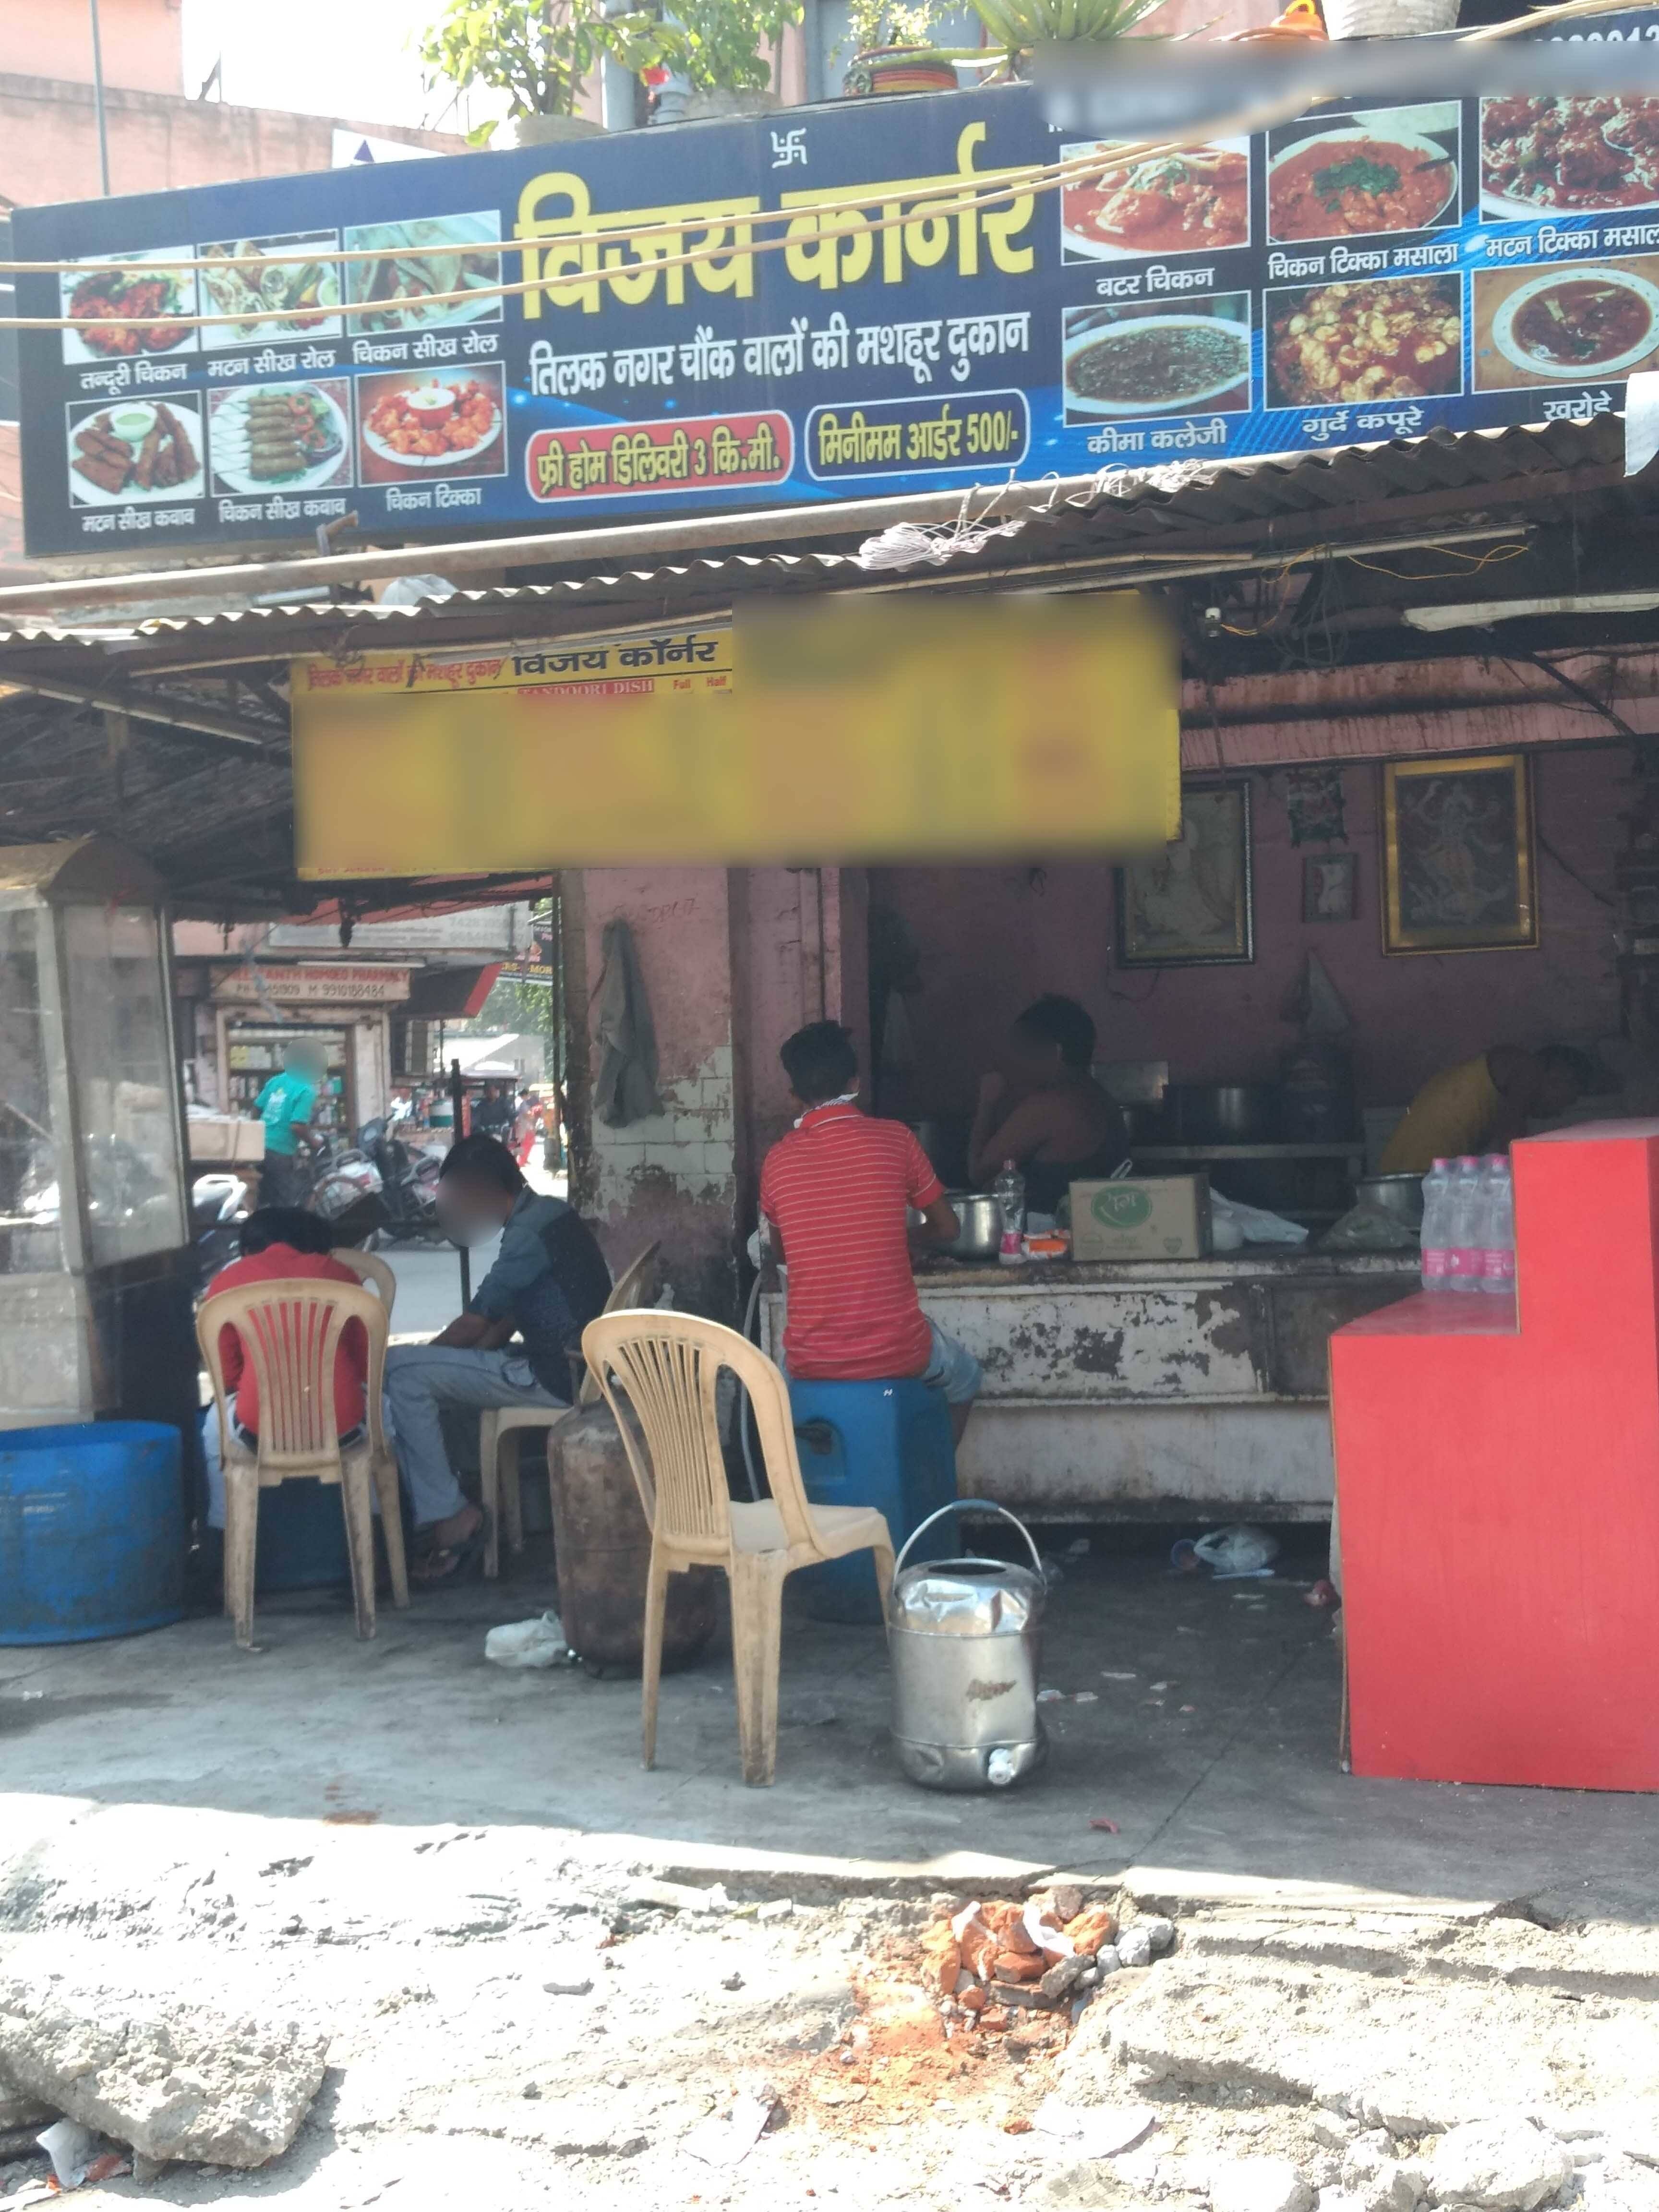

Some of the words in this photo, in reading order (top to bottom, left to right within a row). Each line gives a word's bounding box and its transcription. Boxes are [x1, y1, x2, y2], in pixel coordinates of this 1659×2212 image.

[513, 172, 760, 320] विजय
[780, 121, 1044, 290] कार्नर
[1485, 235, 1535, 257] मटन
[1538, 226, 1599, 254] टिक्का
[1603, 223, 1659, 247] मसाल
[1267, 252, 1326, 279] चिकन
[1329, 246, 1389, 274] टिक्का
[1393, 243, 1459, 267] मसाला
[1095, 275, 1142, 296] बटर
[1145, 265, 1215, 292] चिकन
[208, 359, 248, 377] मटन
[254, 350, 297, 374] सीख
[301, 345, 336, 369] रोल
[352, 340, 408, 365] चिकन
[413, 334, 457, 359] सीख
[462, 330, 499, 353] रोल
[529, 341, 608, 396] तिलक
[613, 346, 675, 386] नगर
[680, 325, 737, 382] चौंक
[742, 316, 809, 376] वालों
[811, 312, 850, 370] की
[855, 320, 943, 384] मशहूर
[946, 312, 1031, 382] दुकान
[80, 363, 131, 394] तन्दूरी
[134, 361, 188, 384] चिकन
[818, 411, 902, 465] मिनीमम
[906, 403, 962, 460] आर्डर
[966, 410, 1018, 454] 500/-
[1087, 427, 1145, 454] कीमा
[1150, 418, 1227, 448] कलेजी
[1302, 410, 1350, 441] गुर्दे
[1356, 406, 1424, 434] कपूरे
[537, 439, 564, 494] फ्री
[568, 439, 607, 490] होम
[612, 429, 689, 485] डिलिवरी
[694, 439, 706, 476] 3
[712, 422, 781, 475] कि.मी.
[218, 499, 262, 523] चिकन
[266, 496, 301, 518] सीख
[386, 488, 431, 511] चिकन
[435, 484, 482, 508] टिक्का
[82, 515, 115, 532] मटन
[118, 506, 152, 530] सीख
[614, 680, 653, 694] DISH
[673, 679, 691, 690] Full
[706, 676, 726, 687] Half
